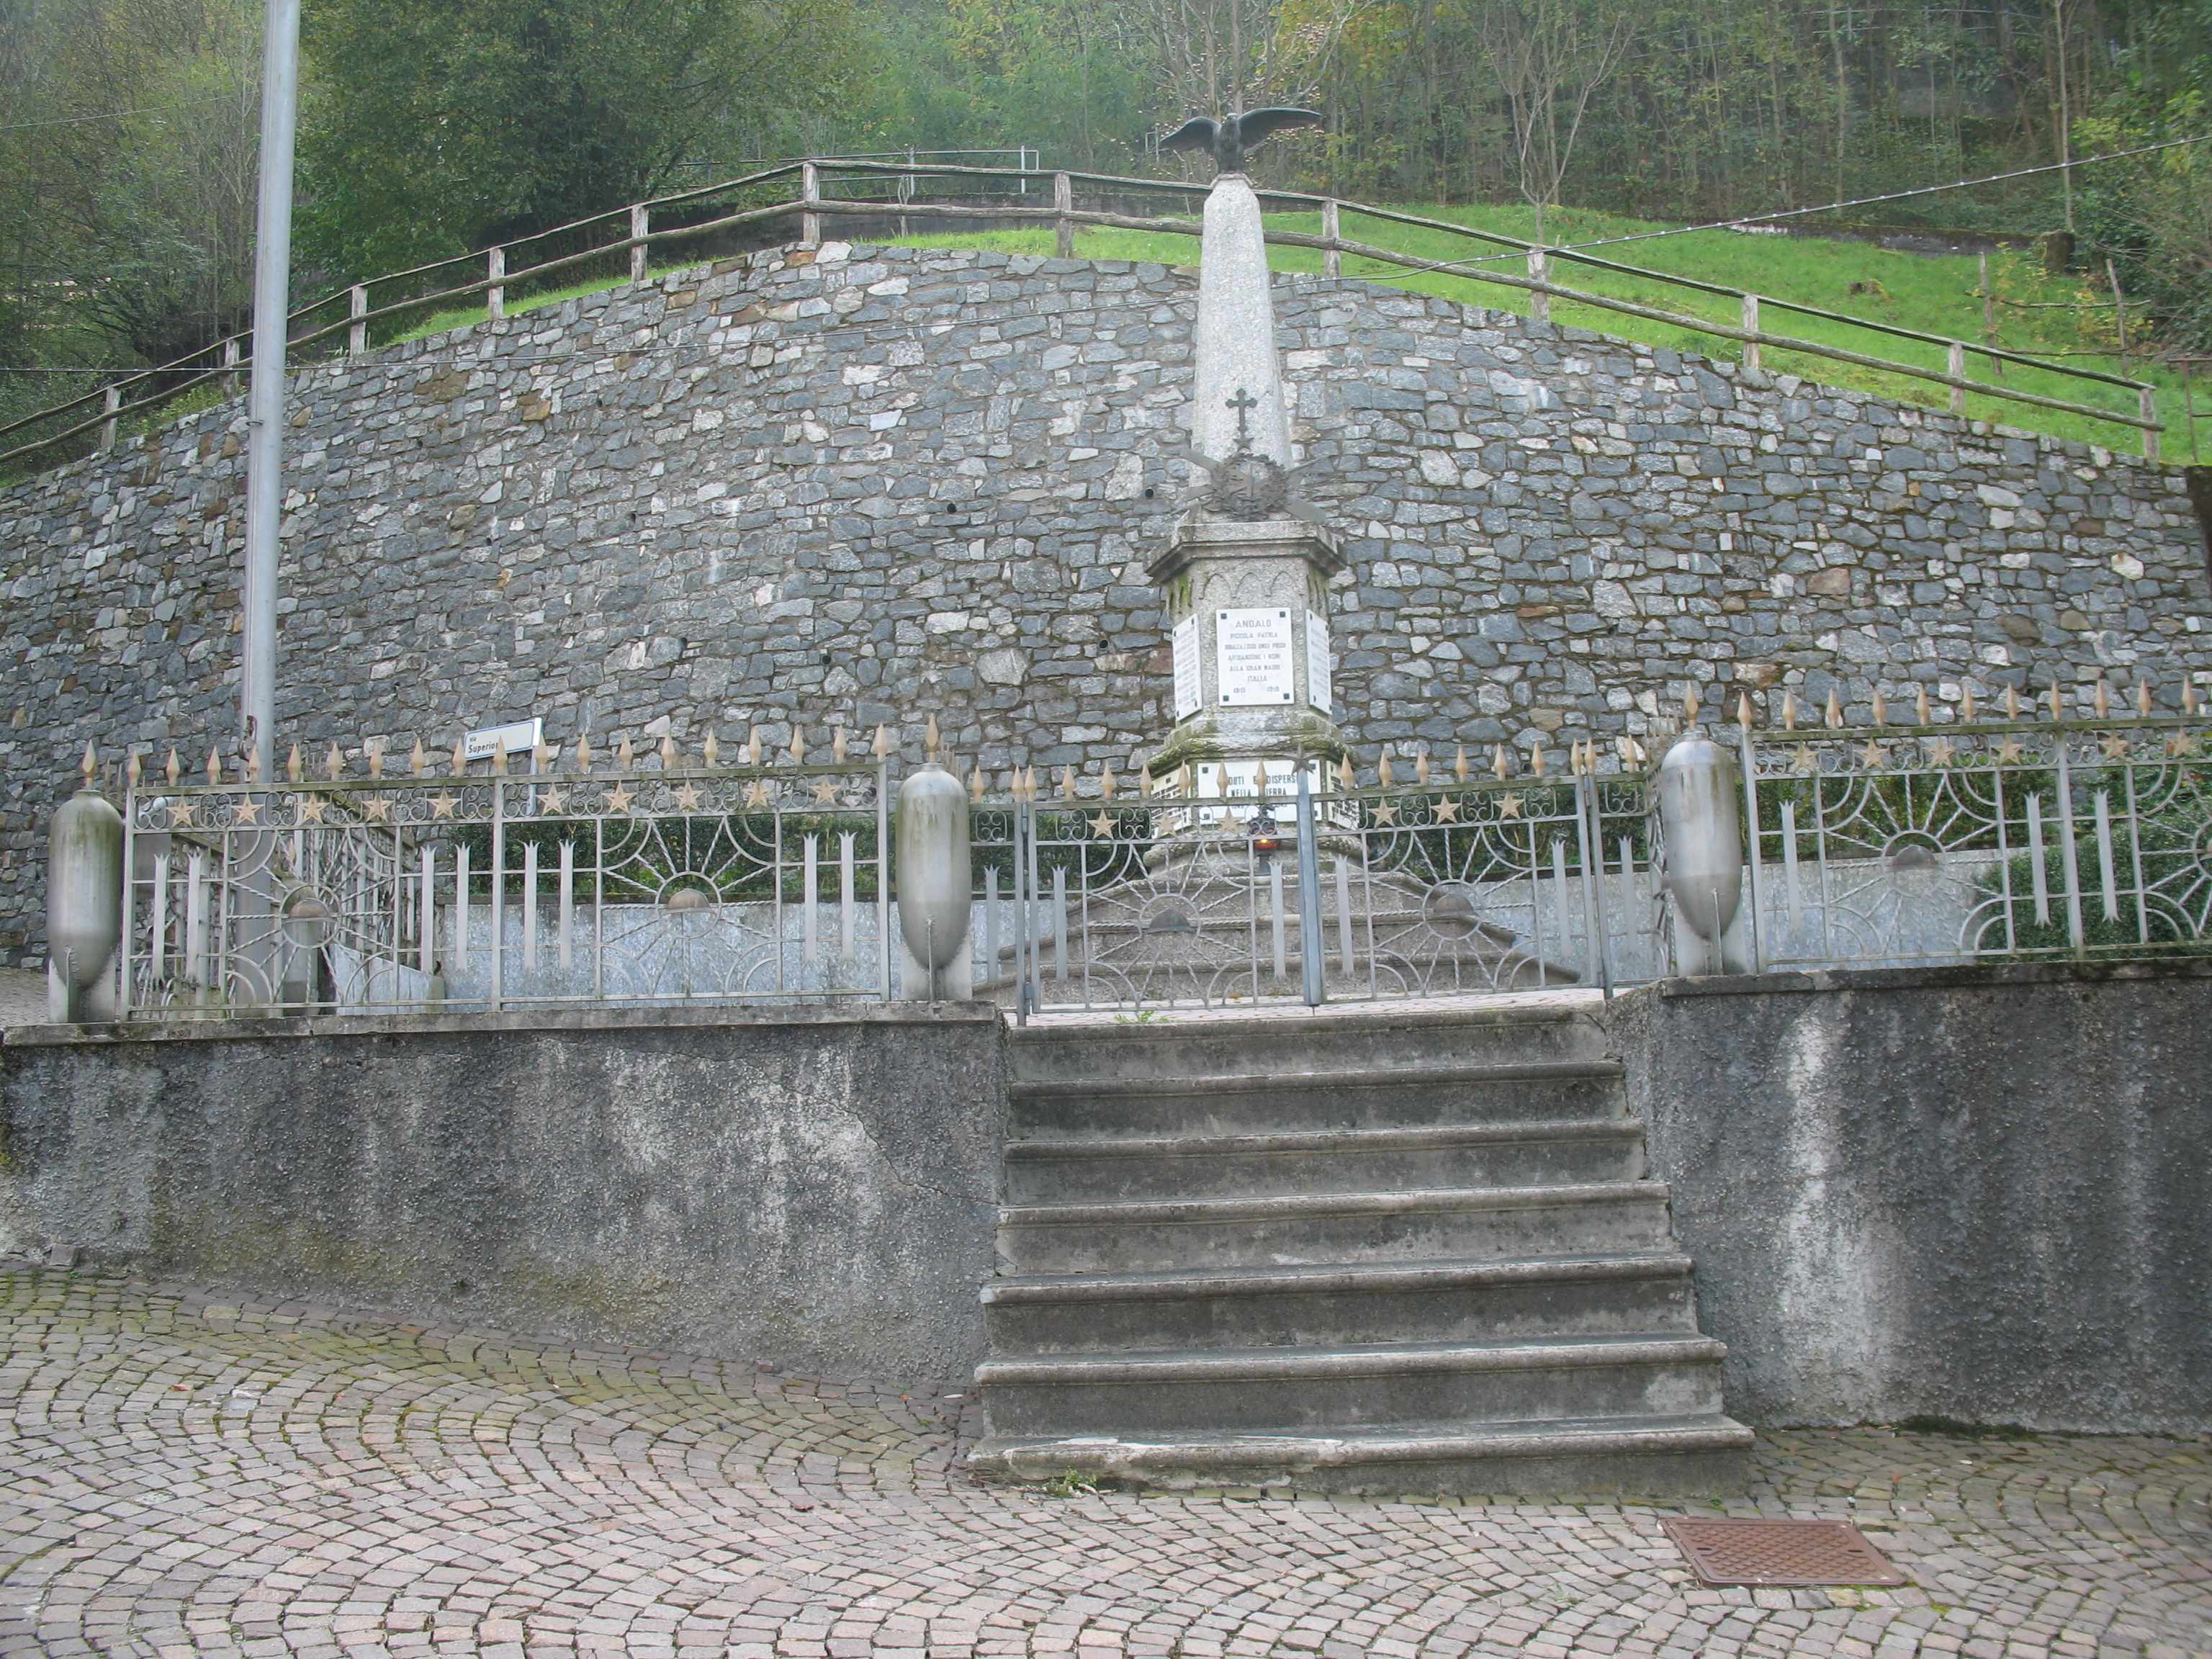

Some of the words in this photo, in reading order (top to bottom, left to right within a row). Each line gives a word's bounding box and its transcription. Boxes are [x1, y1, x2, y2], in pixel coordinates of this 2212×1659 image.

[1235, 619, 1272, 628] ANDALO
[468, 741, 498, 754] Superior
[1228, 775, 1244, 785] DUTI
[1266, 775, 1296, 784] DISPERS
